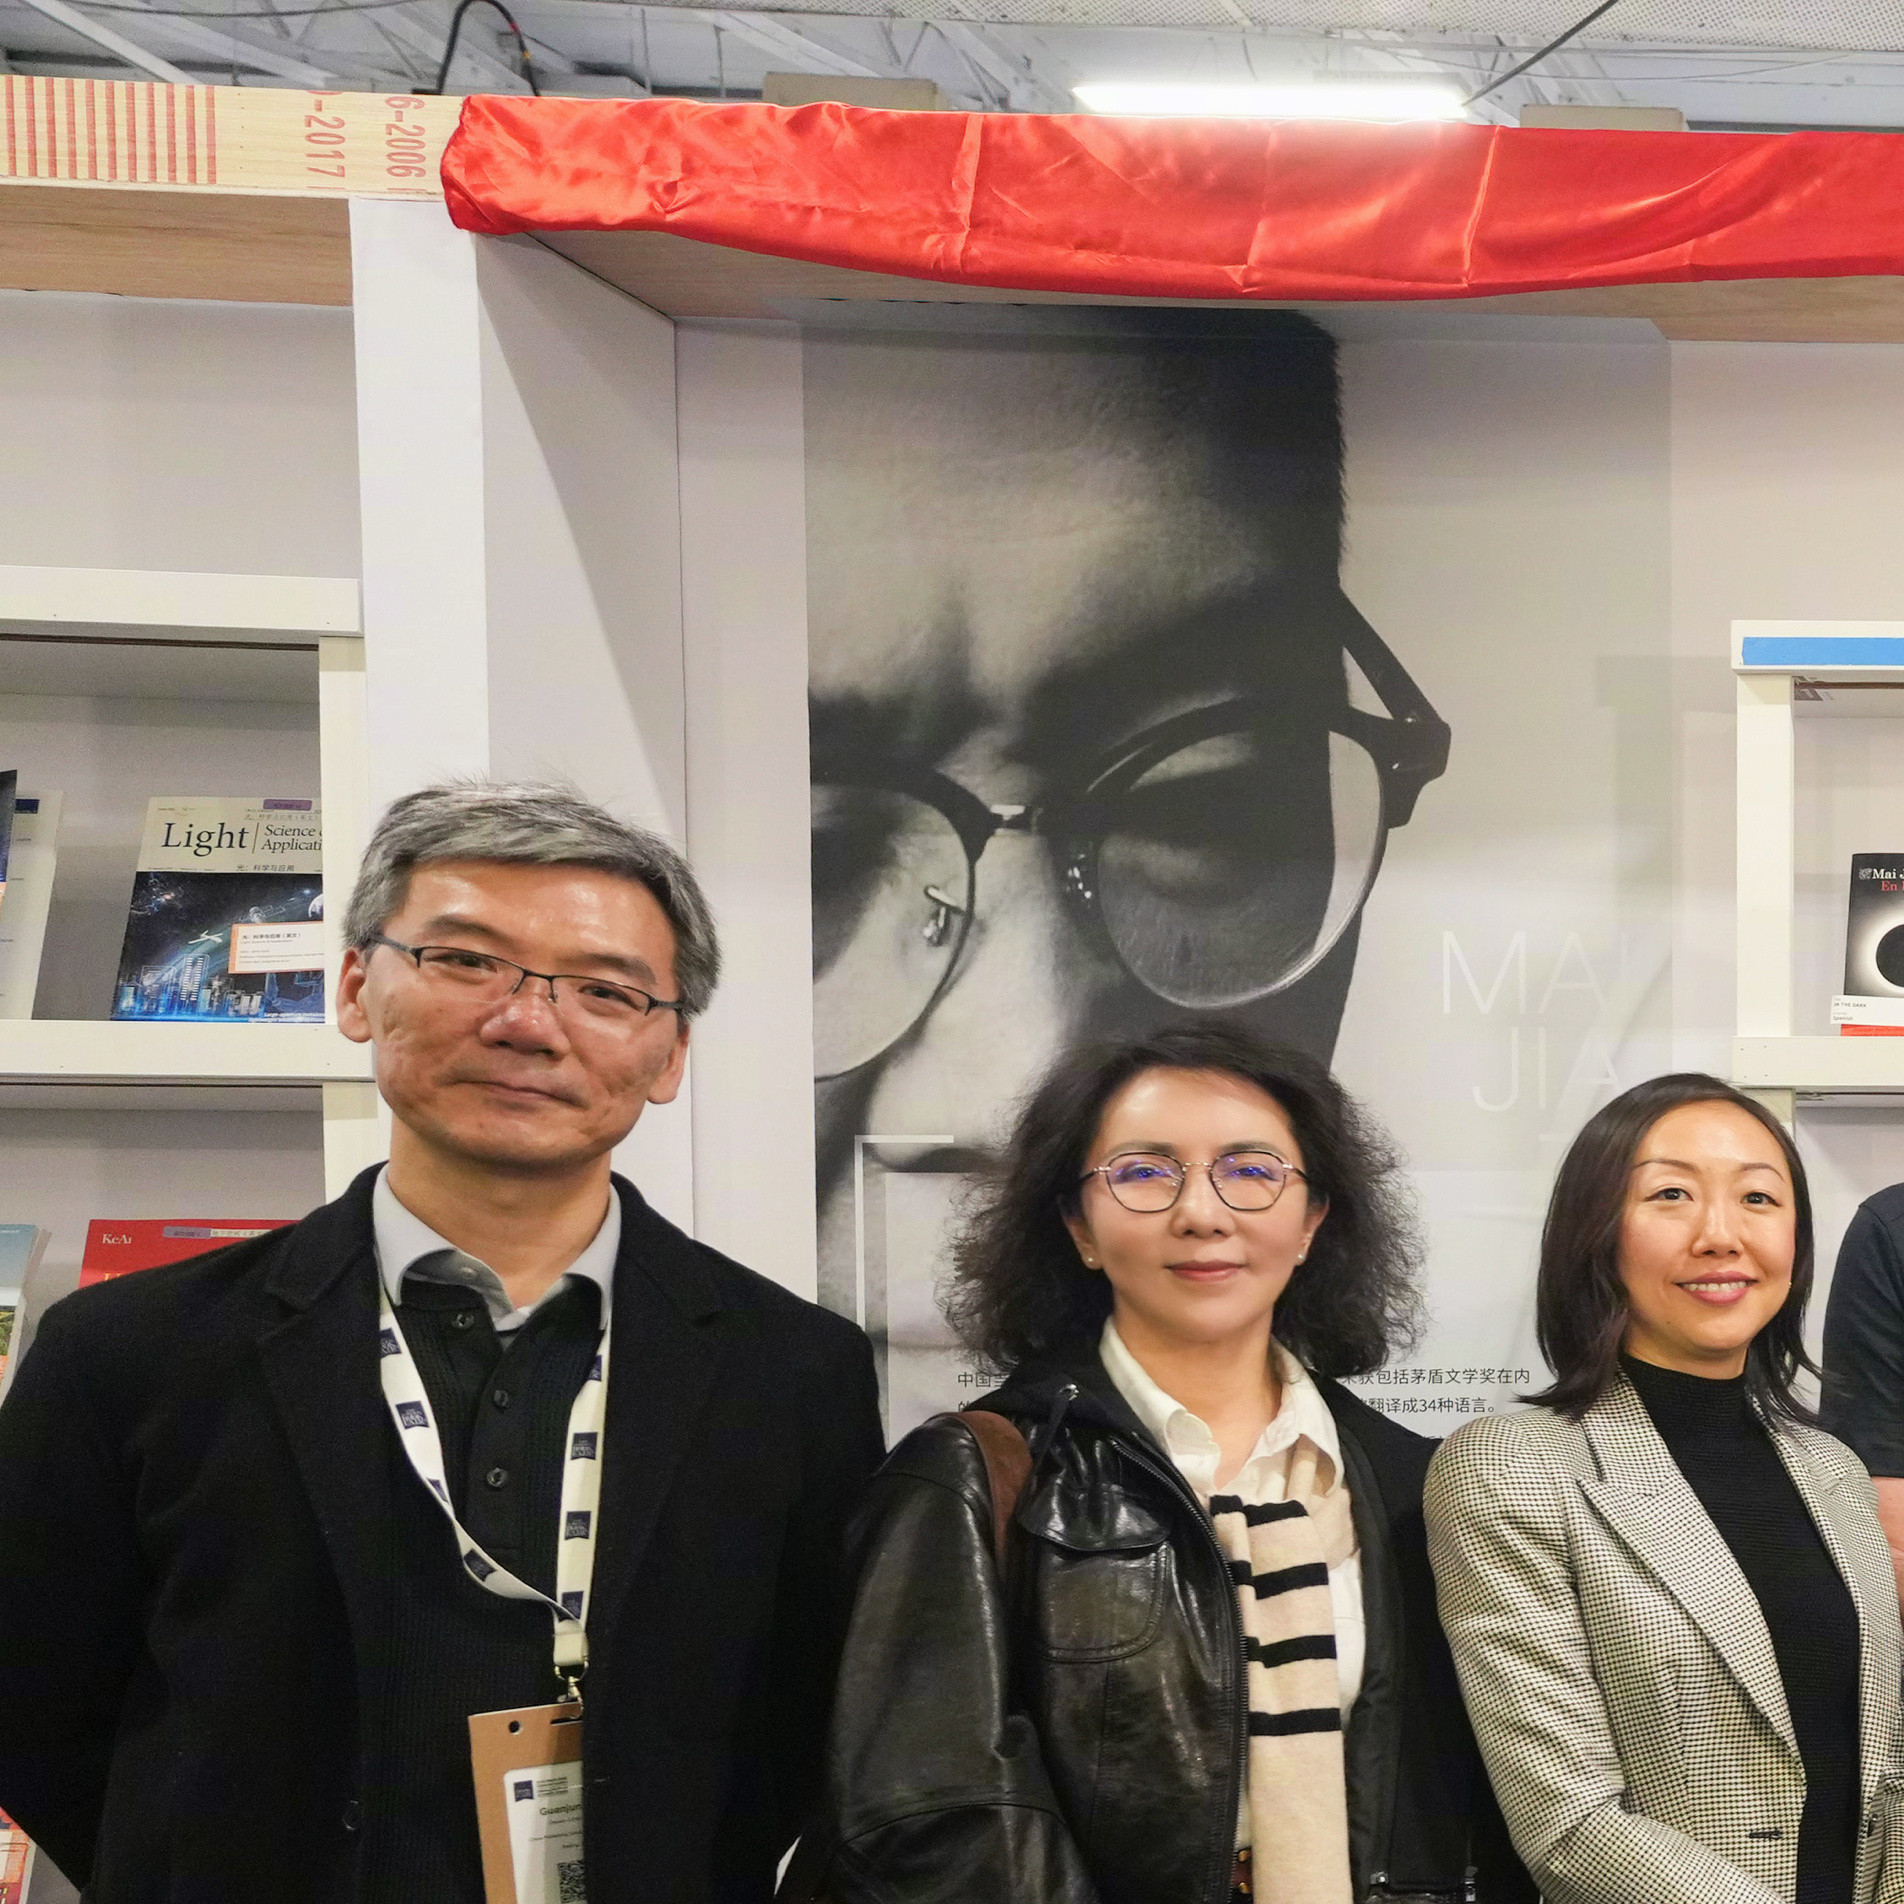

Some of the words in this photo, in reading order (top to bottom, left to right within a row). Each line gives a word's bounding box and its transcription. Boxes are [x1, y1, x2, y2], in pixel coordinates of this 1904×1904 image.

[304, 91, 345, 179] -2017
[385, 96, 426, 179] 6-2006
[161, 822, 249, 857] Light
[264, 825, 316, 837] Science
[1872, 868, 1897, 880] Mai
[1881, 881, 1898, 892] En
[1361, 1397, 1496, 1414] 翻译成34种语言。
